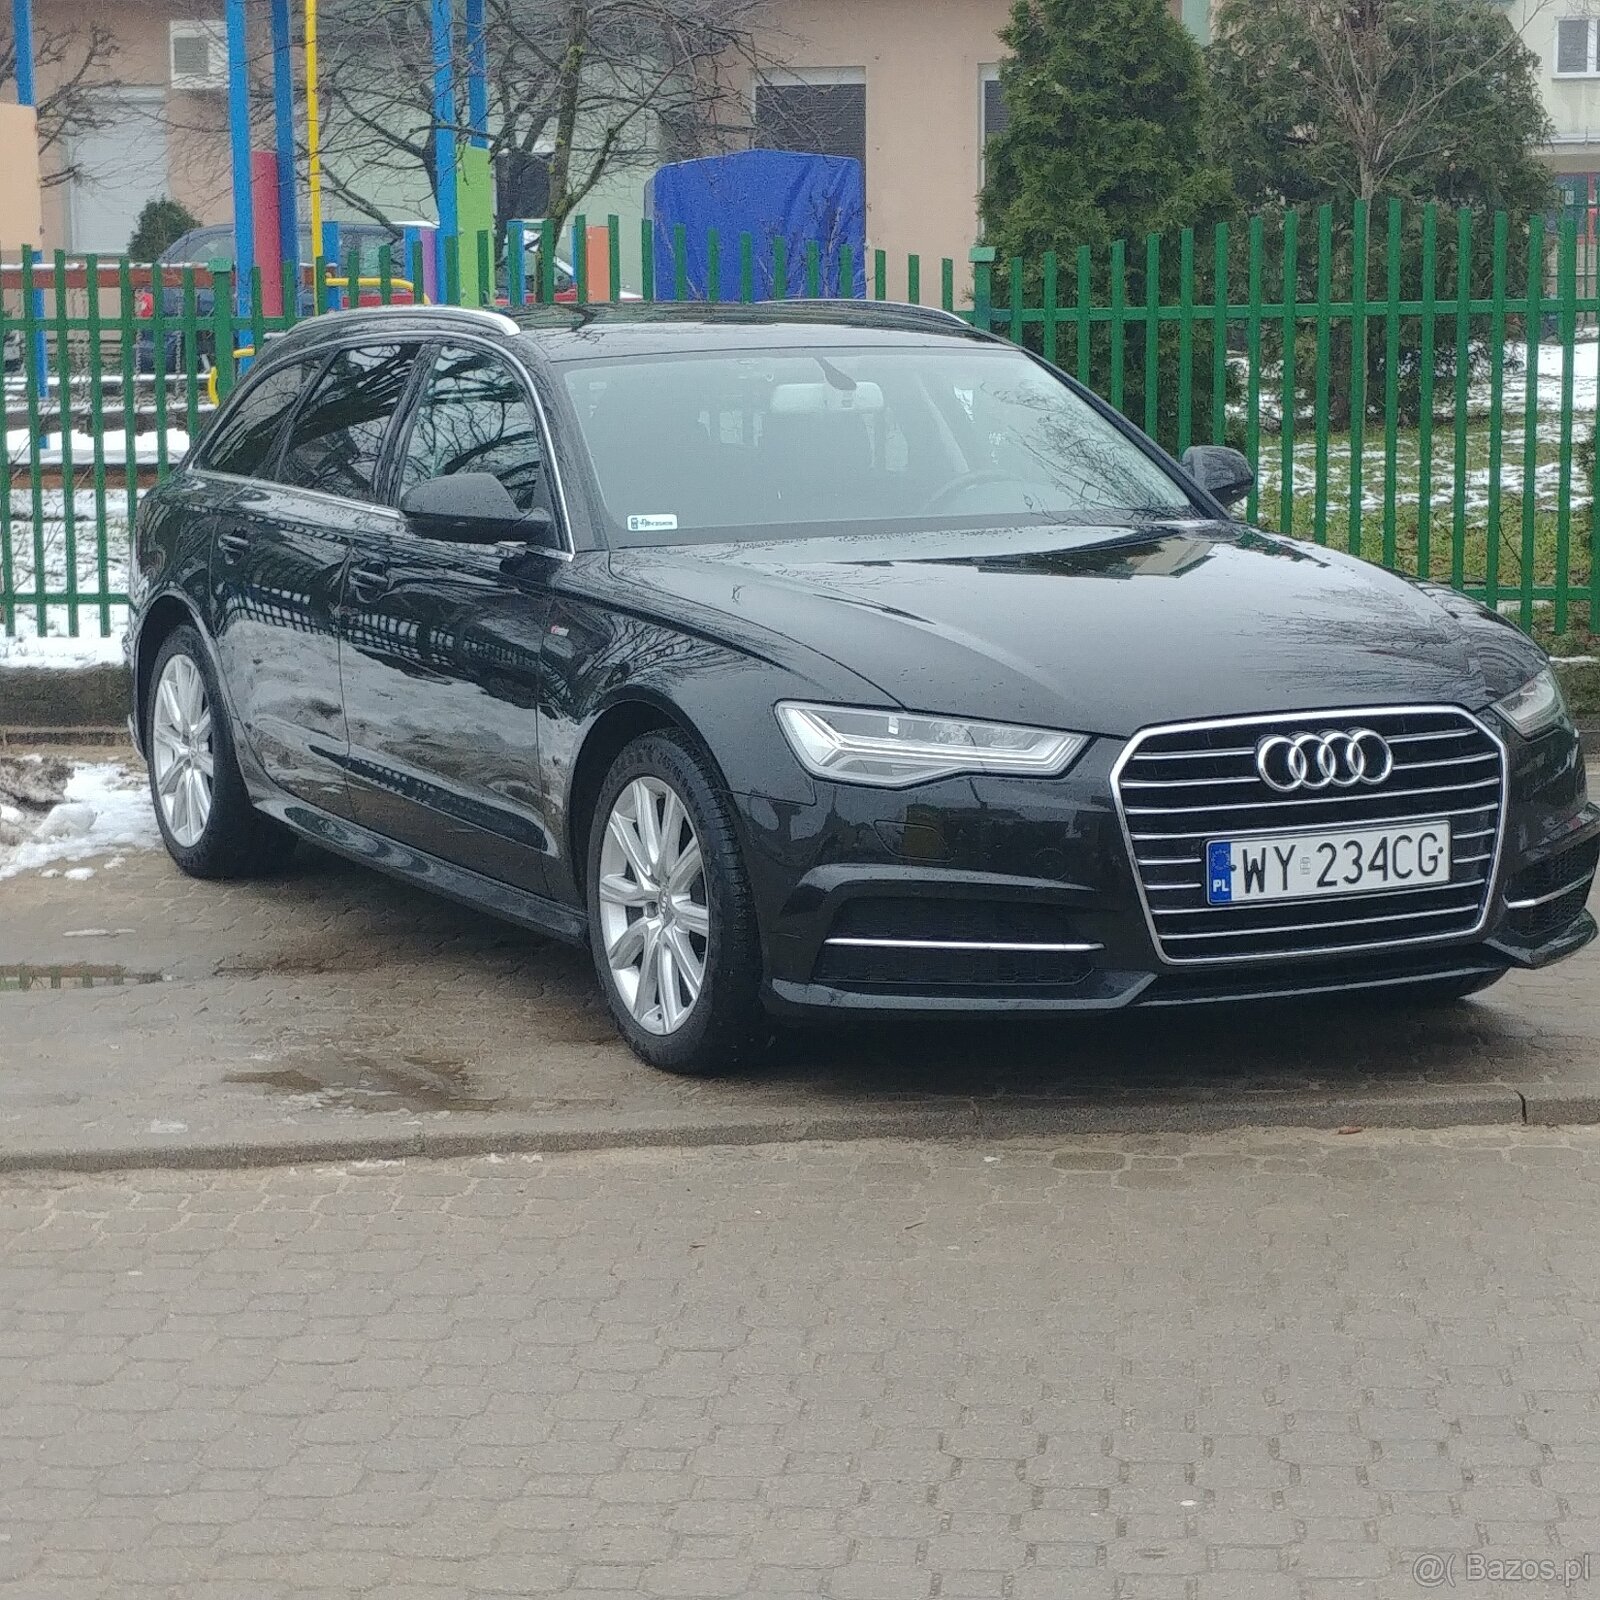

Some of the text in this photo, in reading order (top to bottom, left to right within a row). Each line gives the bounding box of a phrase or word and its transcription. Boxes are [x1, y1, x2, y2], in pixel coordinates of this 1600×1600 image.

[1241, 832, 1439, 894] WY 234CG
[1212, 879, 1229, 892] PL
